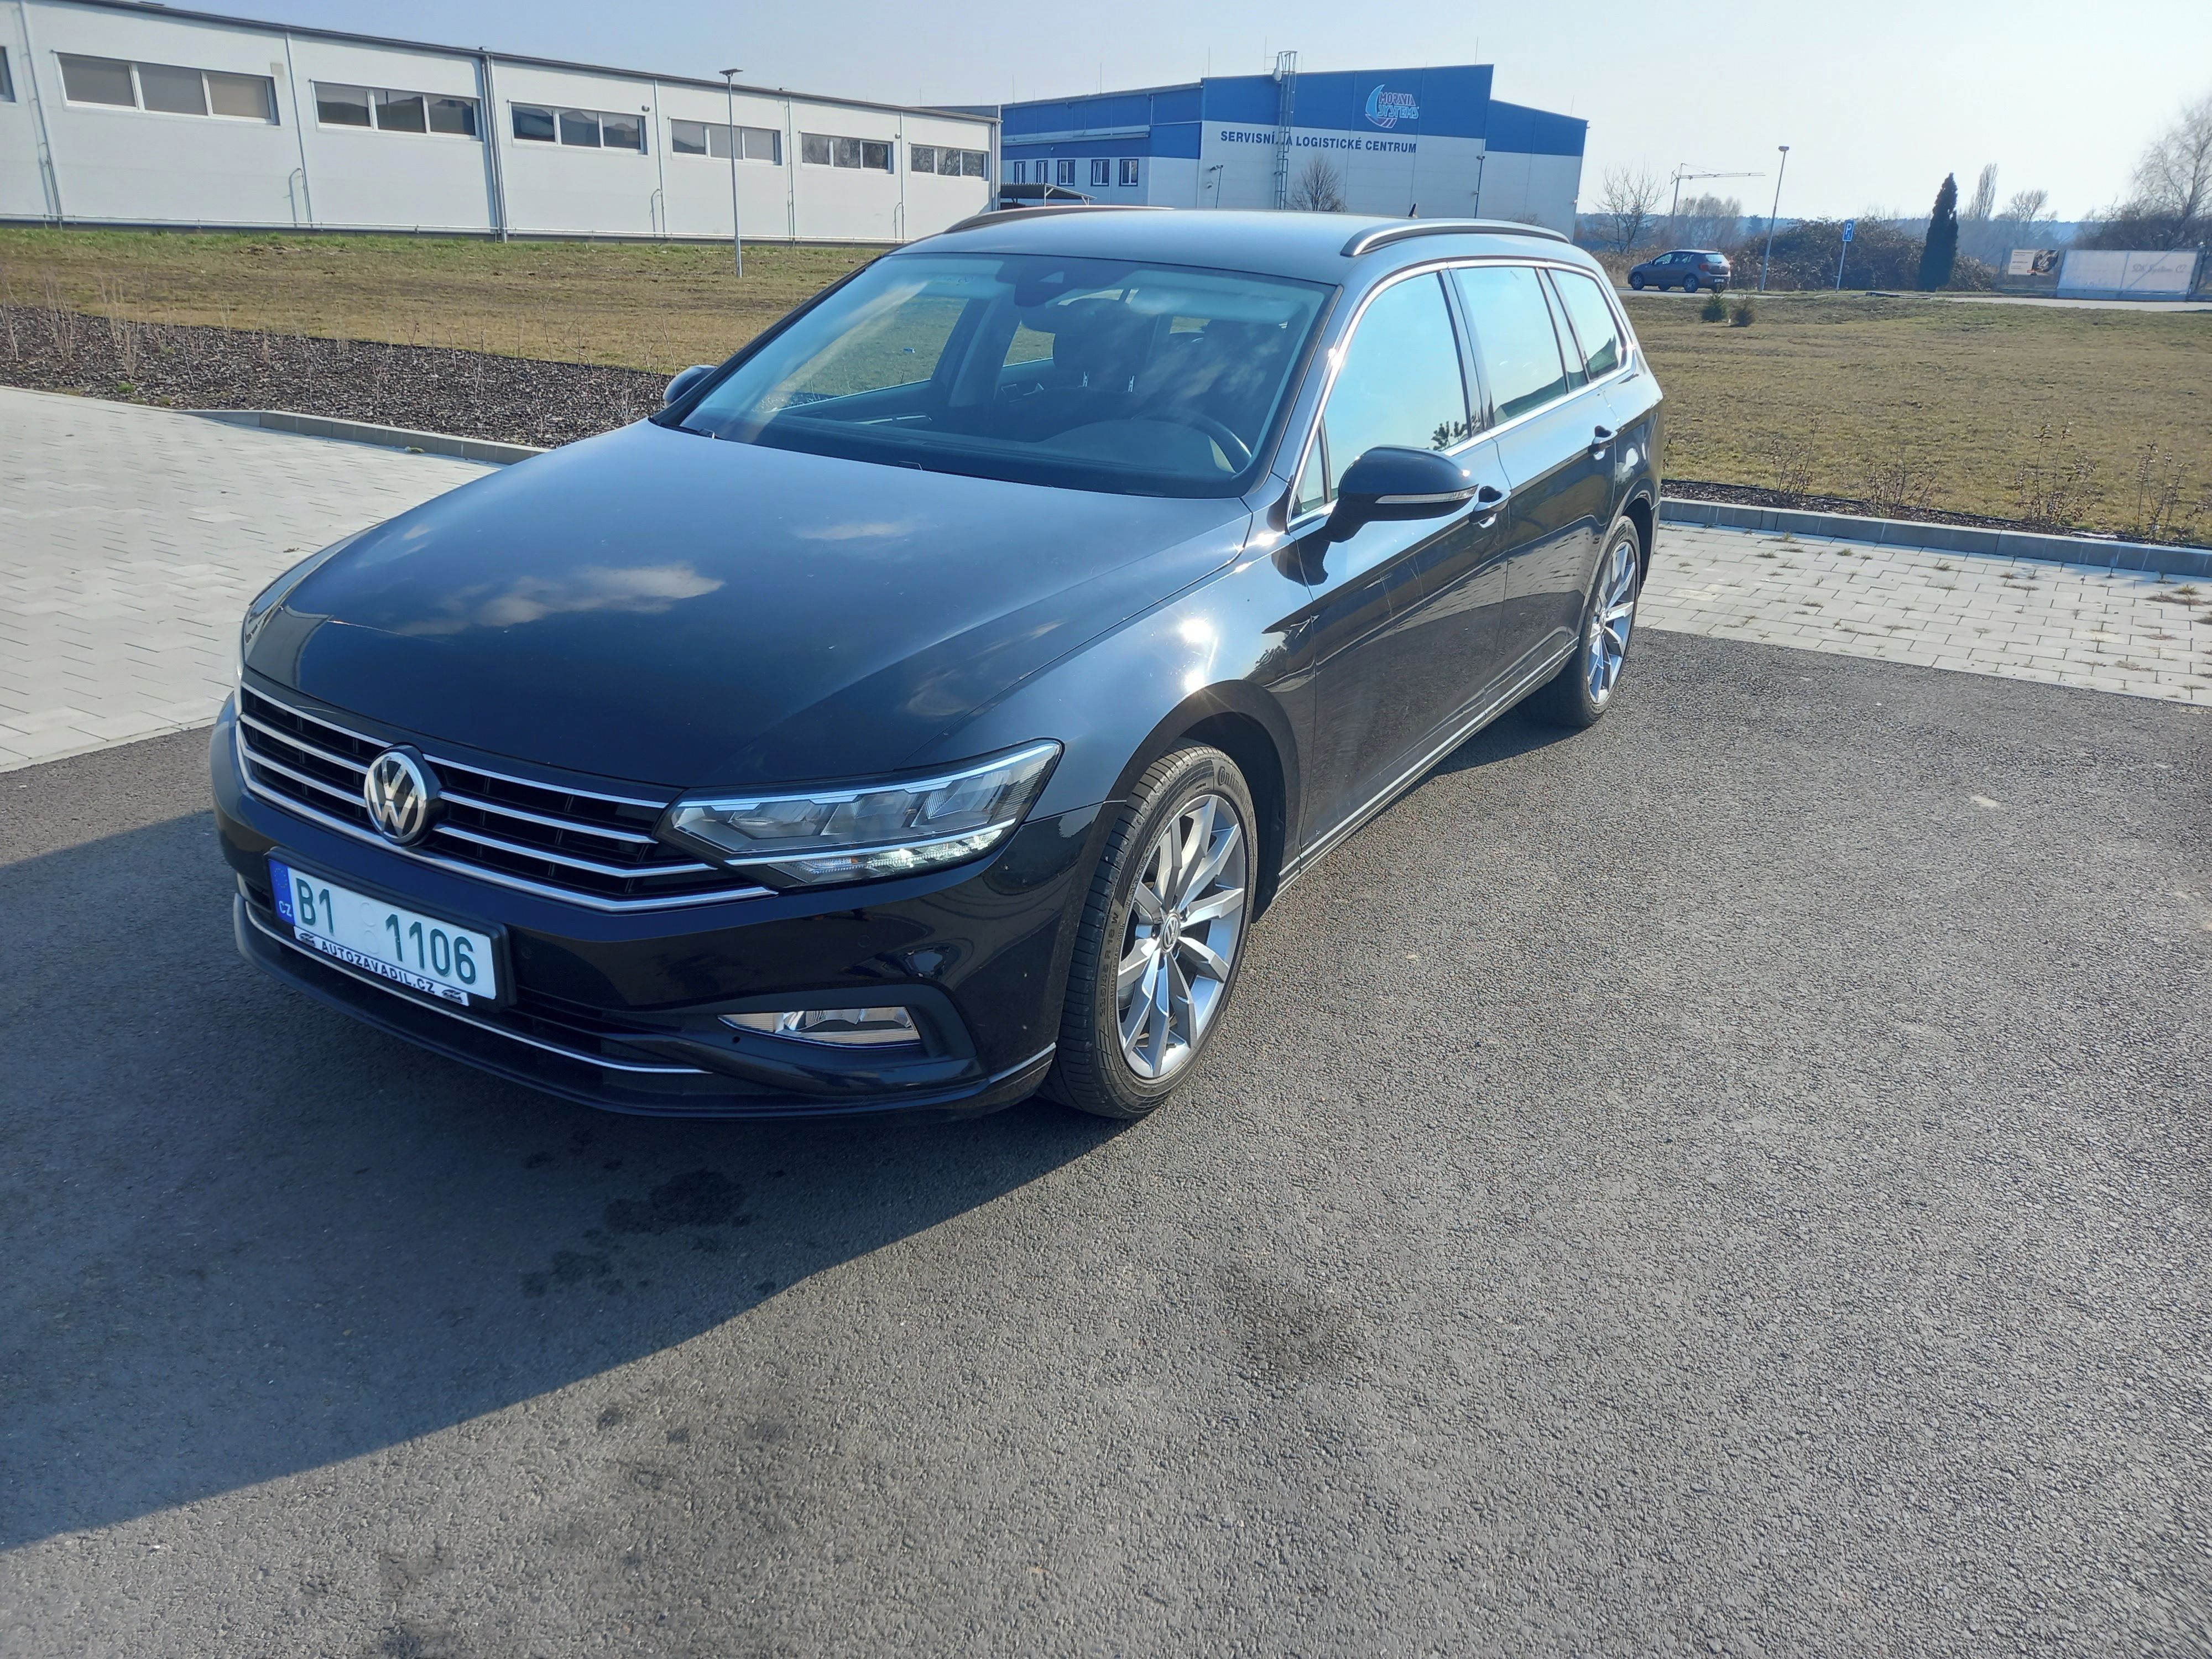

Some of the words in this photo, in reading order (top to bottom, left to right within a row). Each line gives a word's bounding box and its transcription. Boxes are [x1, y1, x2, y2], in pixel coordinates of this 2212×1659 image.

[1379, 92, 1416, 106] MORAVIA
[1378, 105, 1419, 119] SYSTEMS
[1220, 131, 1275, 144] SERVISNÍ
[1296, 136, 1362, 150] LOGISTICKÉ
[1365, 140, 1417, 153] CENTRUM
[1845, 223, 1852, 235] P
[279, 900, 292, 917] CZ
[295, 877, 335, 936] B1
[385, 913, 477, 985] 1106
[321, 941, 436, 994] AUTOZAVADIL.CZ
